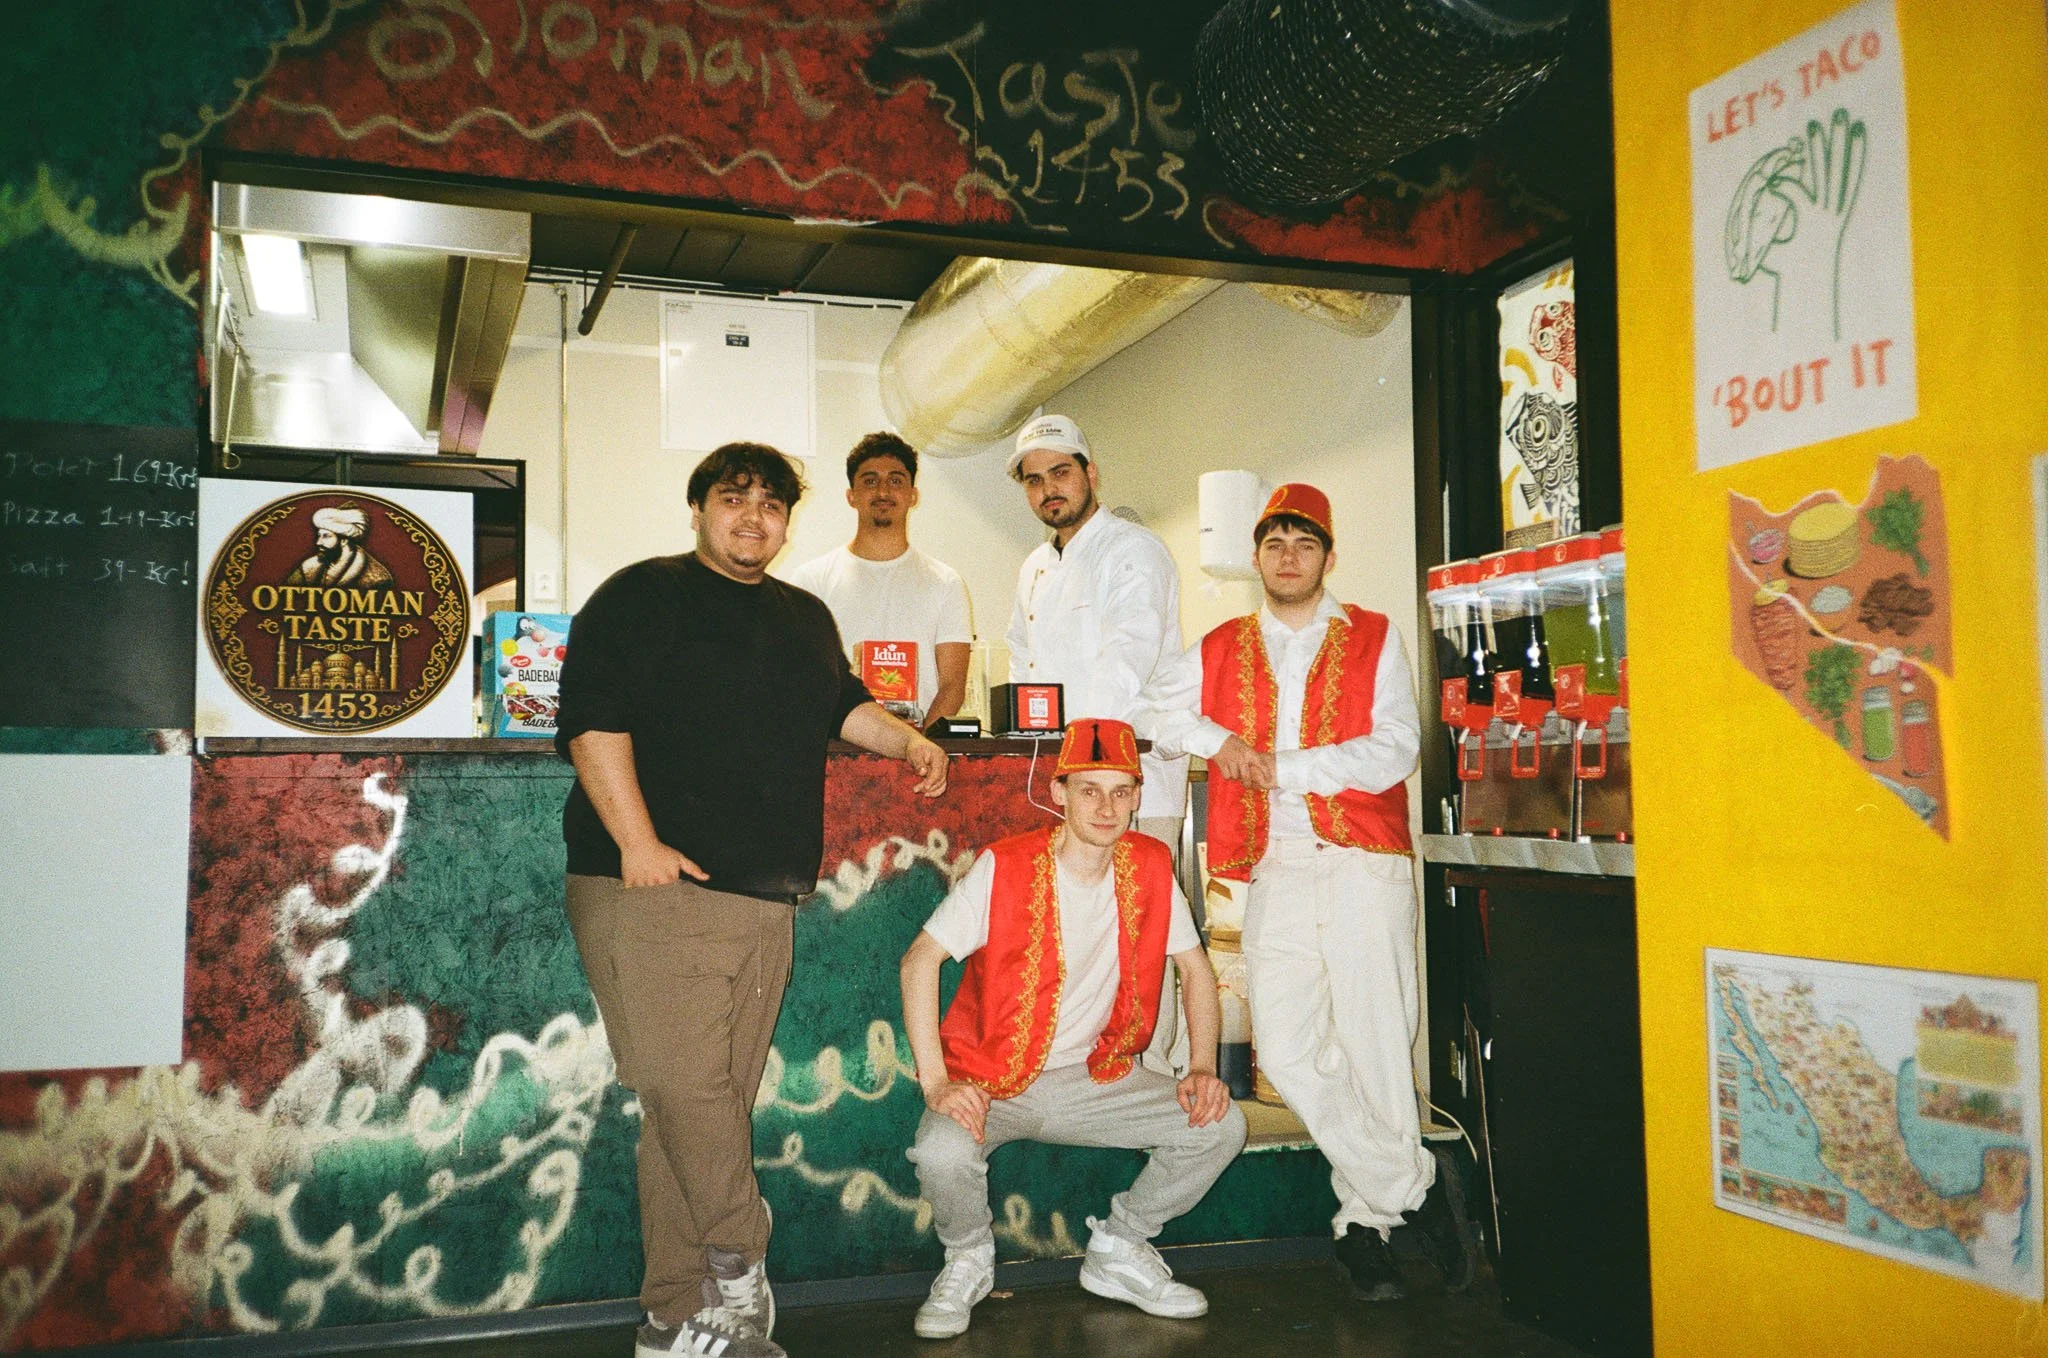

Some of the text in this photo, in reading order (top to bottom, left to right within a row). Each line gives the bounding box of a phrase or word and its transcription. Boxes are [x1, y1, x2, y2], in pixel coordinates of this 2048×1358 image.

[1707, 30, 1881, 143] LET'S TACO
[1022, 128, 1190, 221] 1453
[1851, 338, 1893, 388] IT
[3, 502, 83, 525] Pizza
[252, 585, 424, 616] OTTOMAN
[284, 615, 391, 642] TASTE
[298, 692, 378, 719] 1453
